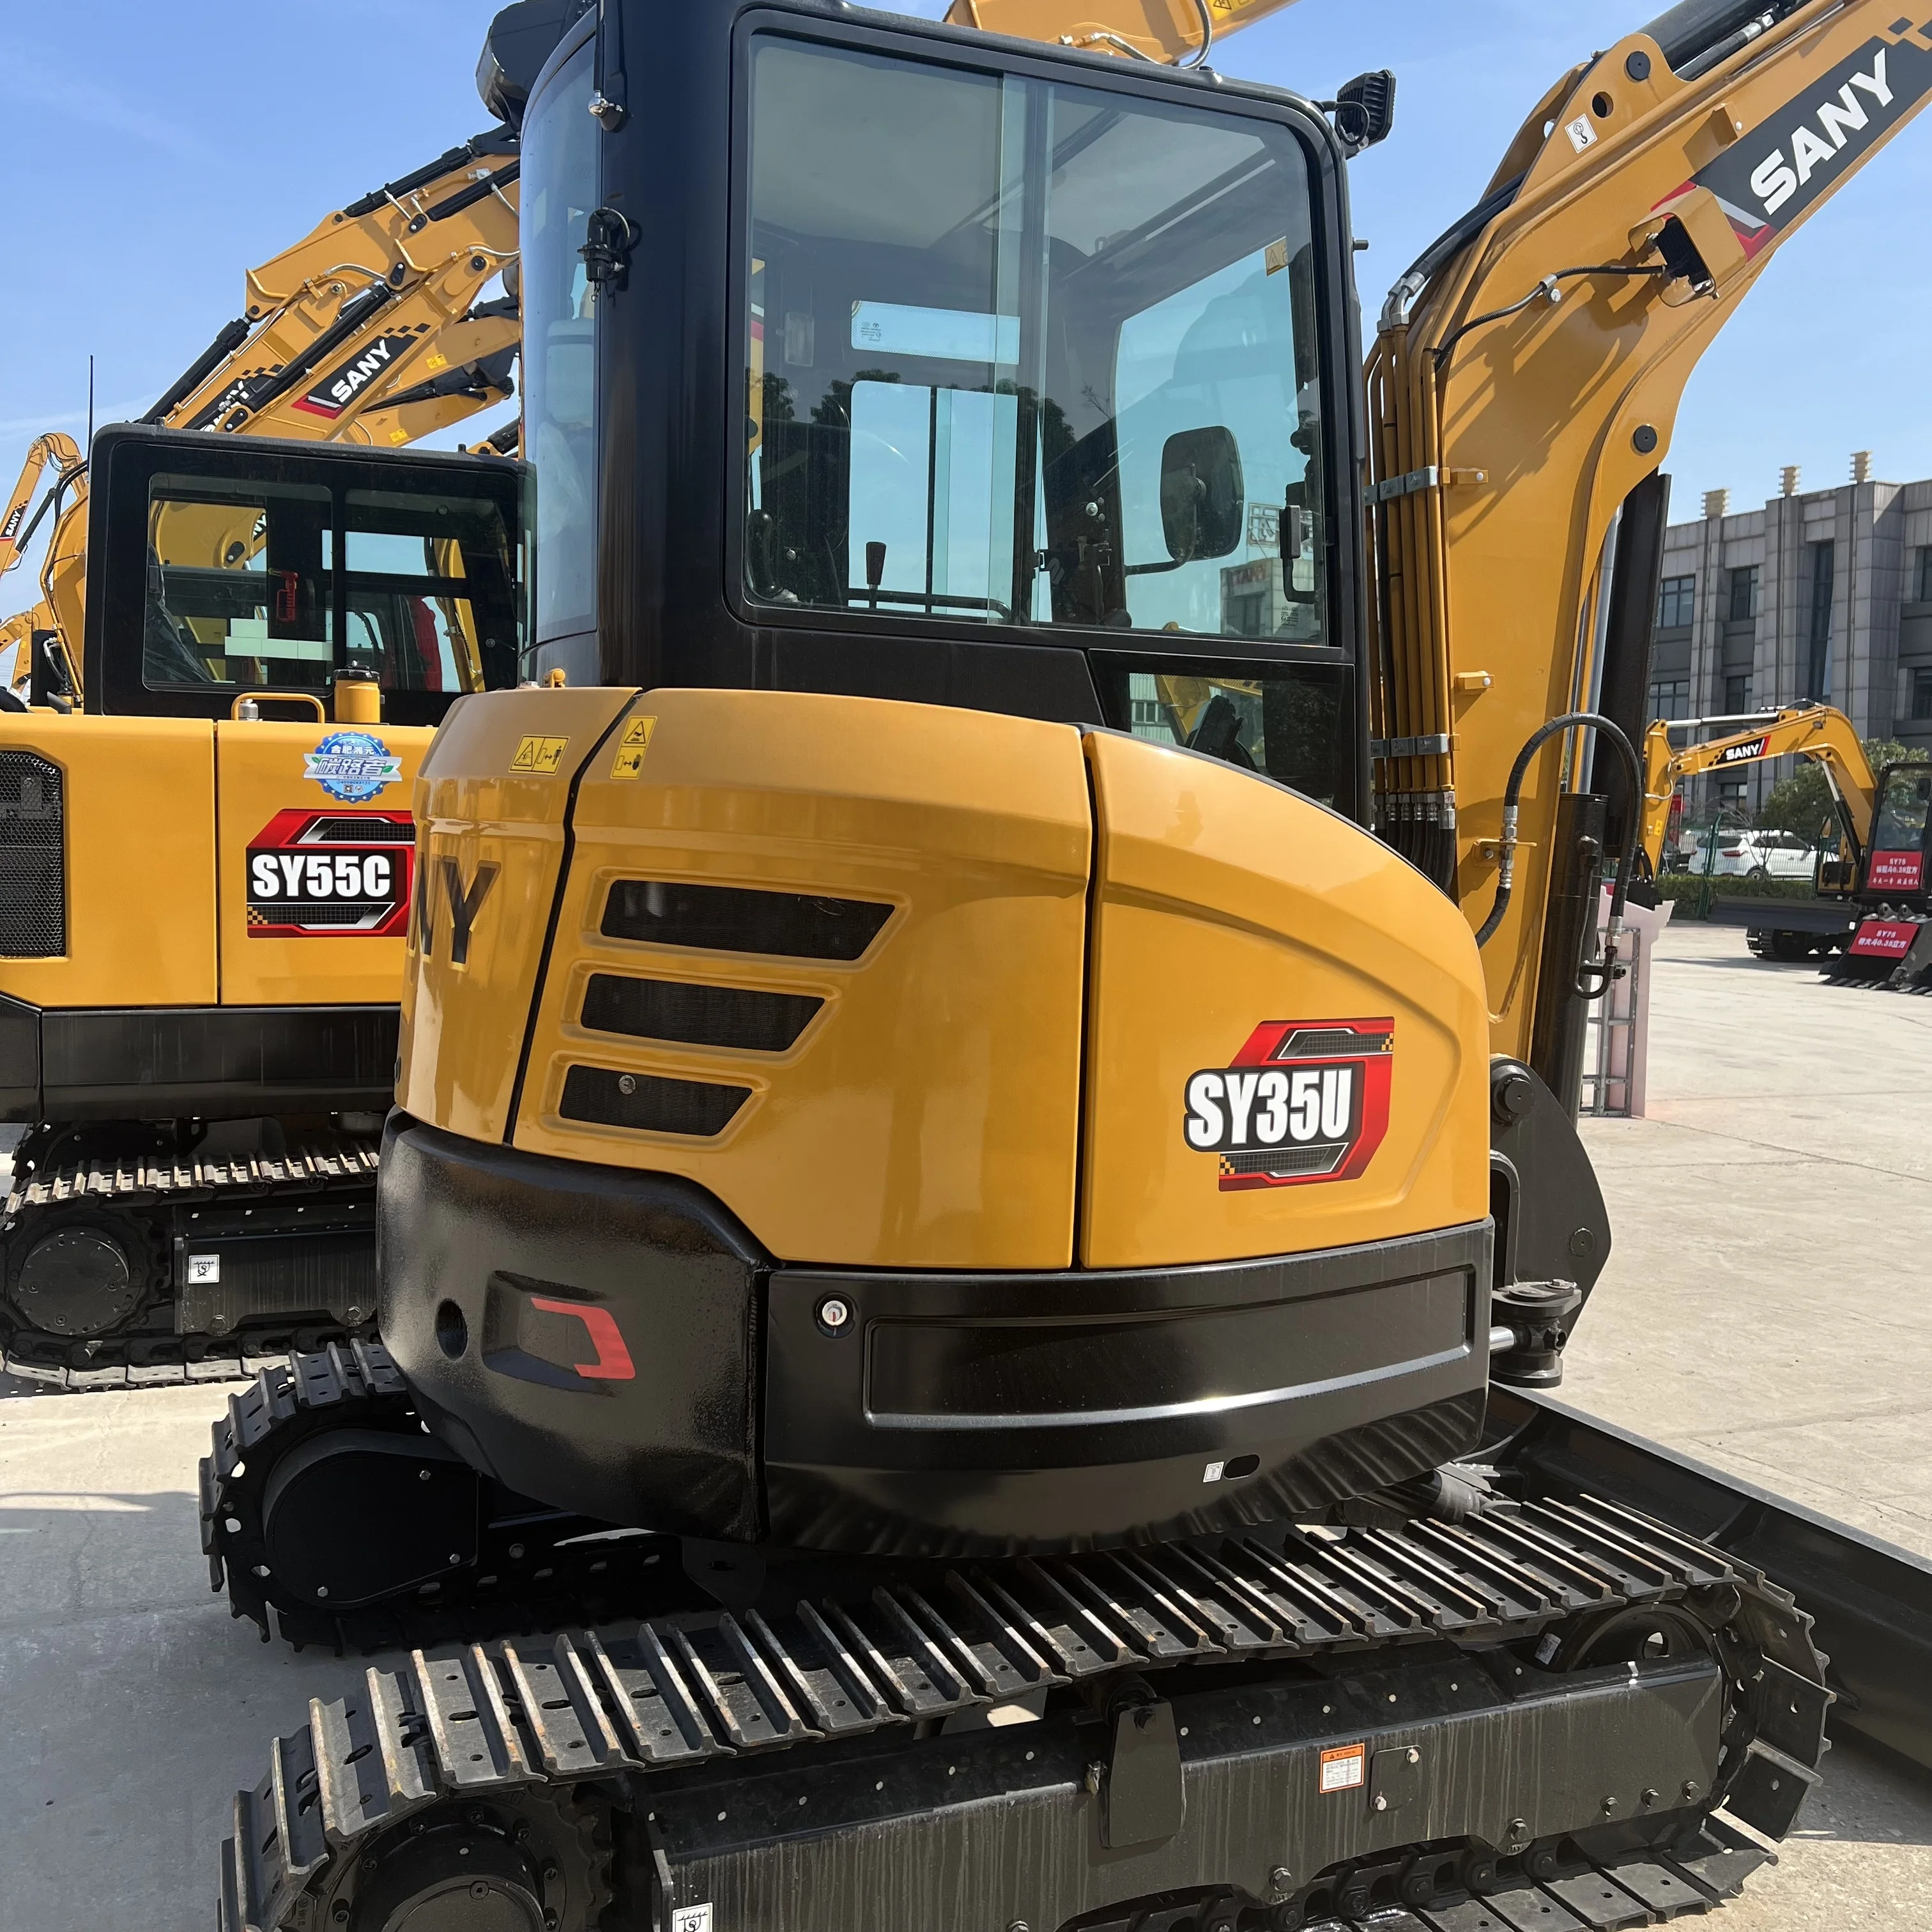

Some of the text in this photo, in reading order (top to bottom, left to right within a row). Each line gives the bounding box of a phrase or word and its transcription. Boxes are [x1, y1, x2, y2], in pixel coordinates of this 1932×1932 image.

[1750, 47, 1894, 217] SANY
[331, 339, 392, 404] SANY
[5, 510, 21, 537] SANY
[314, 757, 387, 777] 碳路者
[1726, 743, 1759, 761] SANY
[252, 854, 390, 898] SY55C
[1187, 1068, 1353, 1147] SY35U
